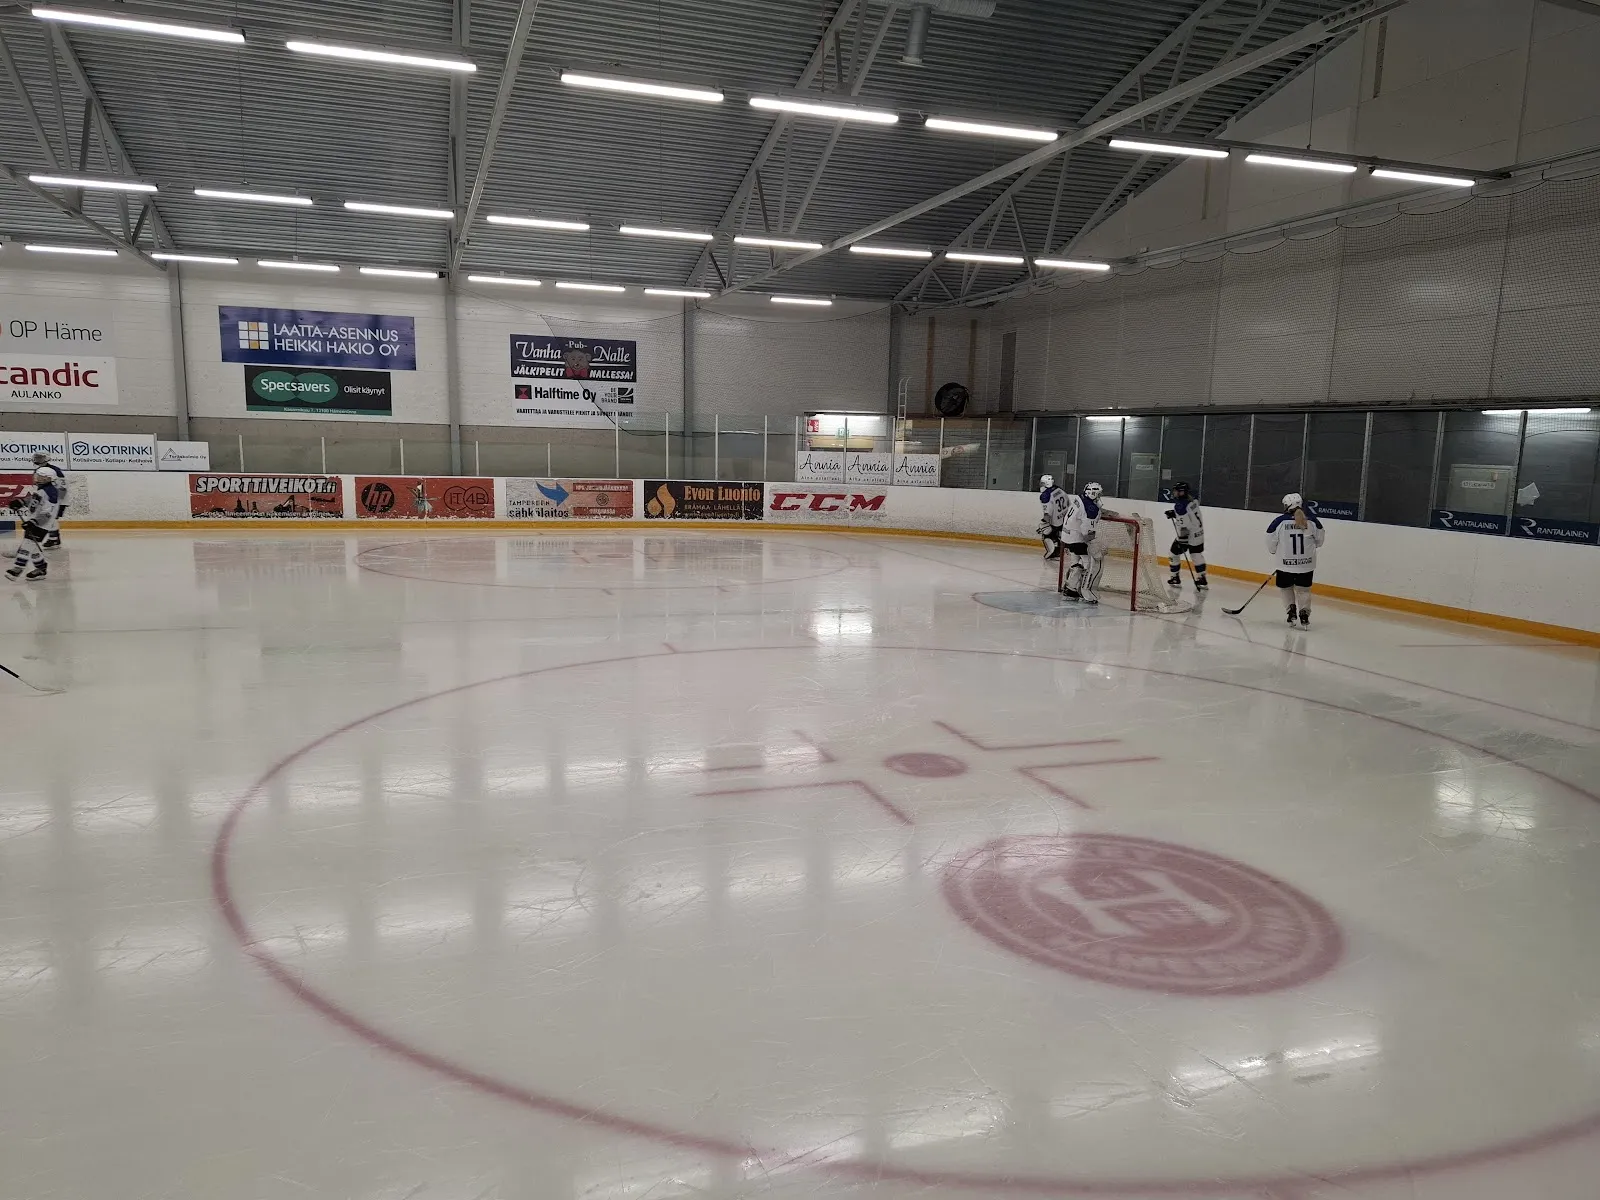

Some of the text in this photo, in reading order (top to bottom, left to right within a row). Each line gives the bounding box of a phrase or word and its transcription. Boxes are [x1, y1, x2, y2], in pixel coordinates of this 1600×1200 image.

[10, 320, 102, 341] OP Häme
[273, 323, 399, 342] LAATTA-ASENNUS
[274, 338, 400, 357] HEIKKI HAKIO OY
[515, 341, 631, 363] Vanha Nalle
[0, 362, 99, 388] candic
[513, 364, 634, 380] JÄLKIPELIT NALLESSA!
[11, 390, 62, 400] AULANKO
[260, 378, 331, 394] Specsavers
[343, 385, 386, 396] Olisit käynyt
[534, 387, 597, 402] Halftime Oy
[92, 445, 152, 456] KOTIRINKI
[799, 453, 842, 474] Annia
[847, 454, 890, 475] Annia
[895, 456, 937, 477] Annia
[365, 483, 392, 513] hp
[684, 485, 761, 502] Evon Luonto
[769, 493, 886, 512] CCM
[1055, 496, 1067, 513] 32
[1318, 507, 1353, 516] RANTALAINEN
[1453, 519, 1499, 530] RANTALAINEN
[1536, 527, 1589, 539] RANTALAINEN
[1290, 533, 1304, 555] 11
